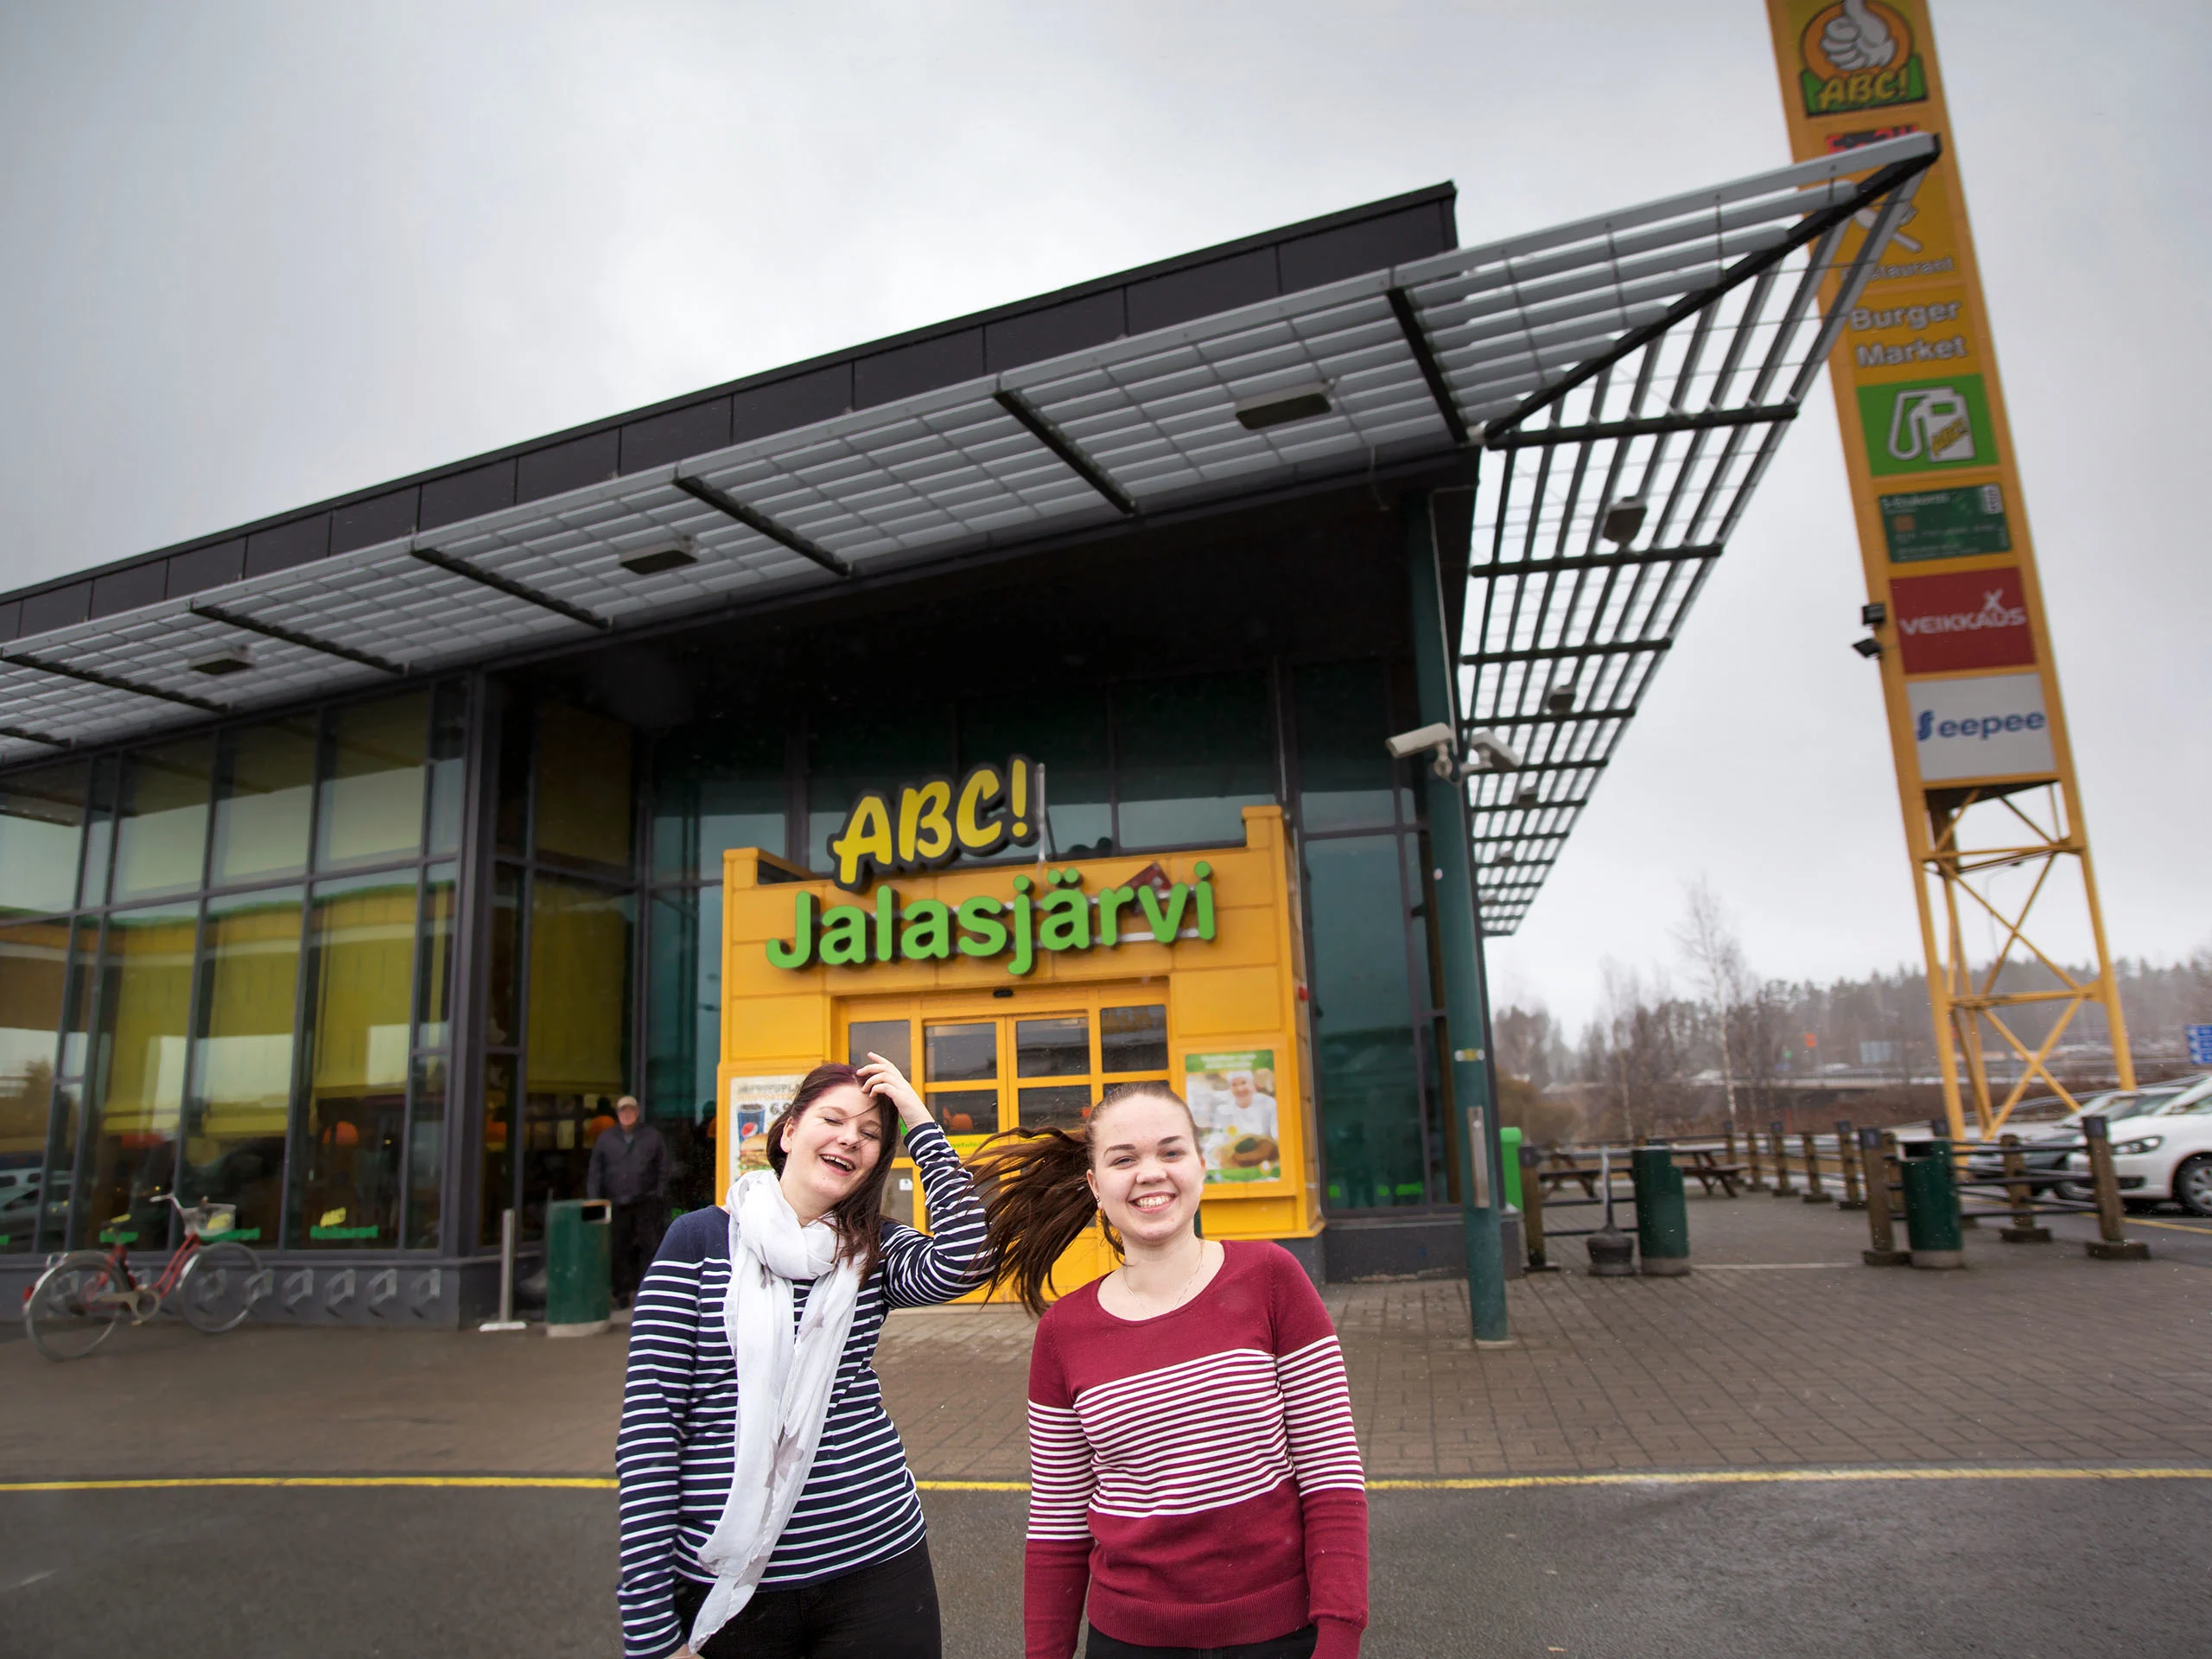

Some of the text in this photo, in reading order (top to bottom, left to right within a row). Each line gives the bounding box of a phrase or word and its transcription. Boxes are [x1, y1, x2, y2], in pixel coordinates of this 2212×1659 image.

[1818, 67, 1908, 111] ABC!
[1850, 301, 1961, 332] Burger
[1857, 334, 1968, 368] Market
[1900, 596, 2027, 635] VEIKKAUS
[831, 759, 1028, 885] ABC!
[766, 861, 1215, 976] Jalasjärvi
